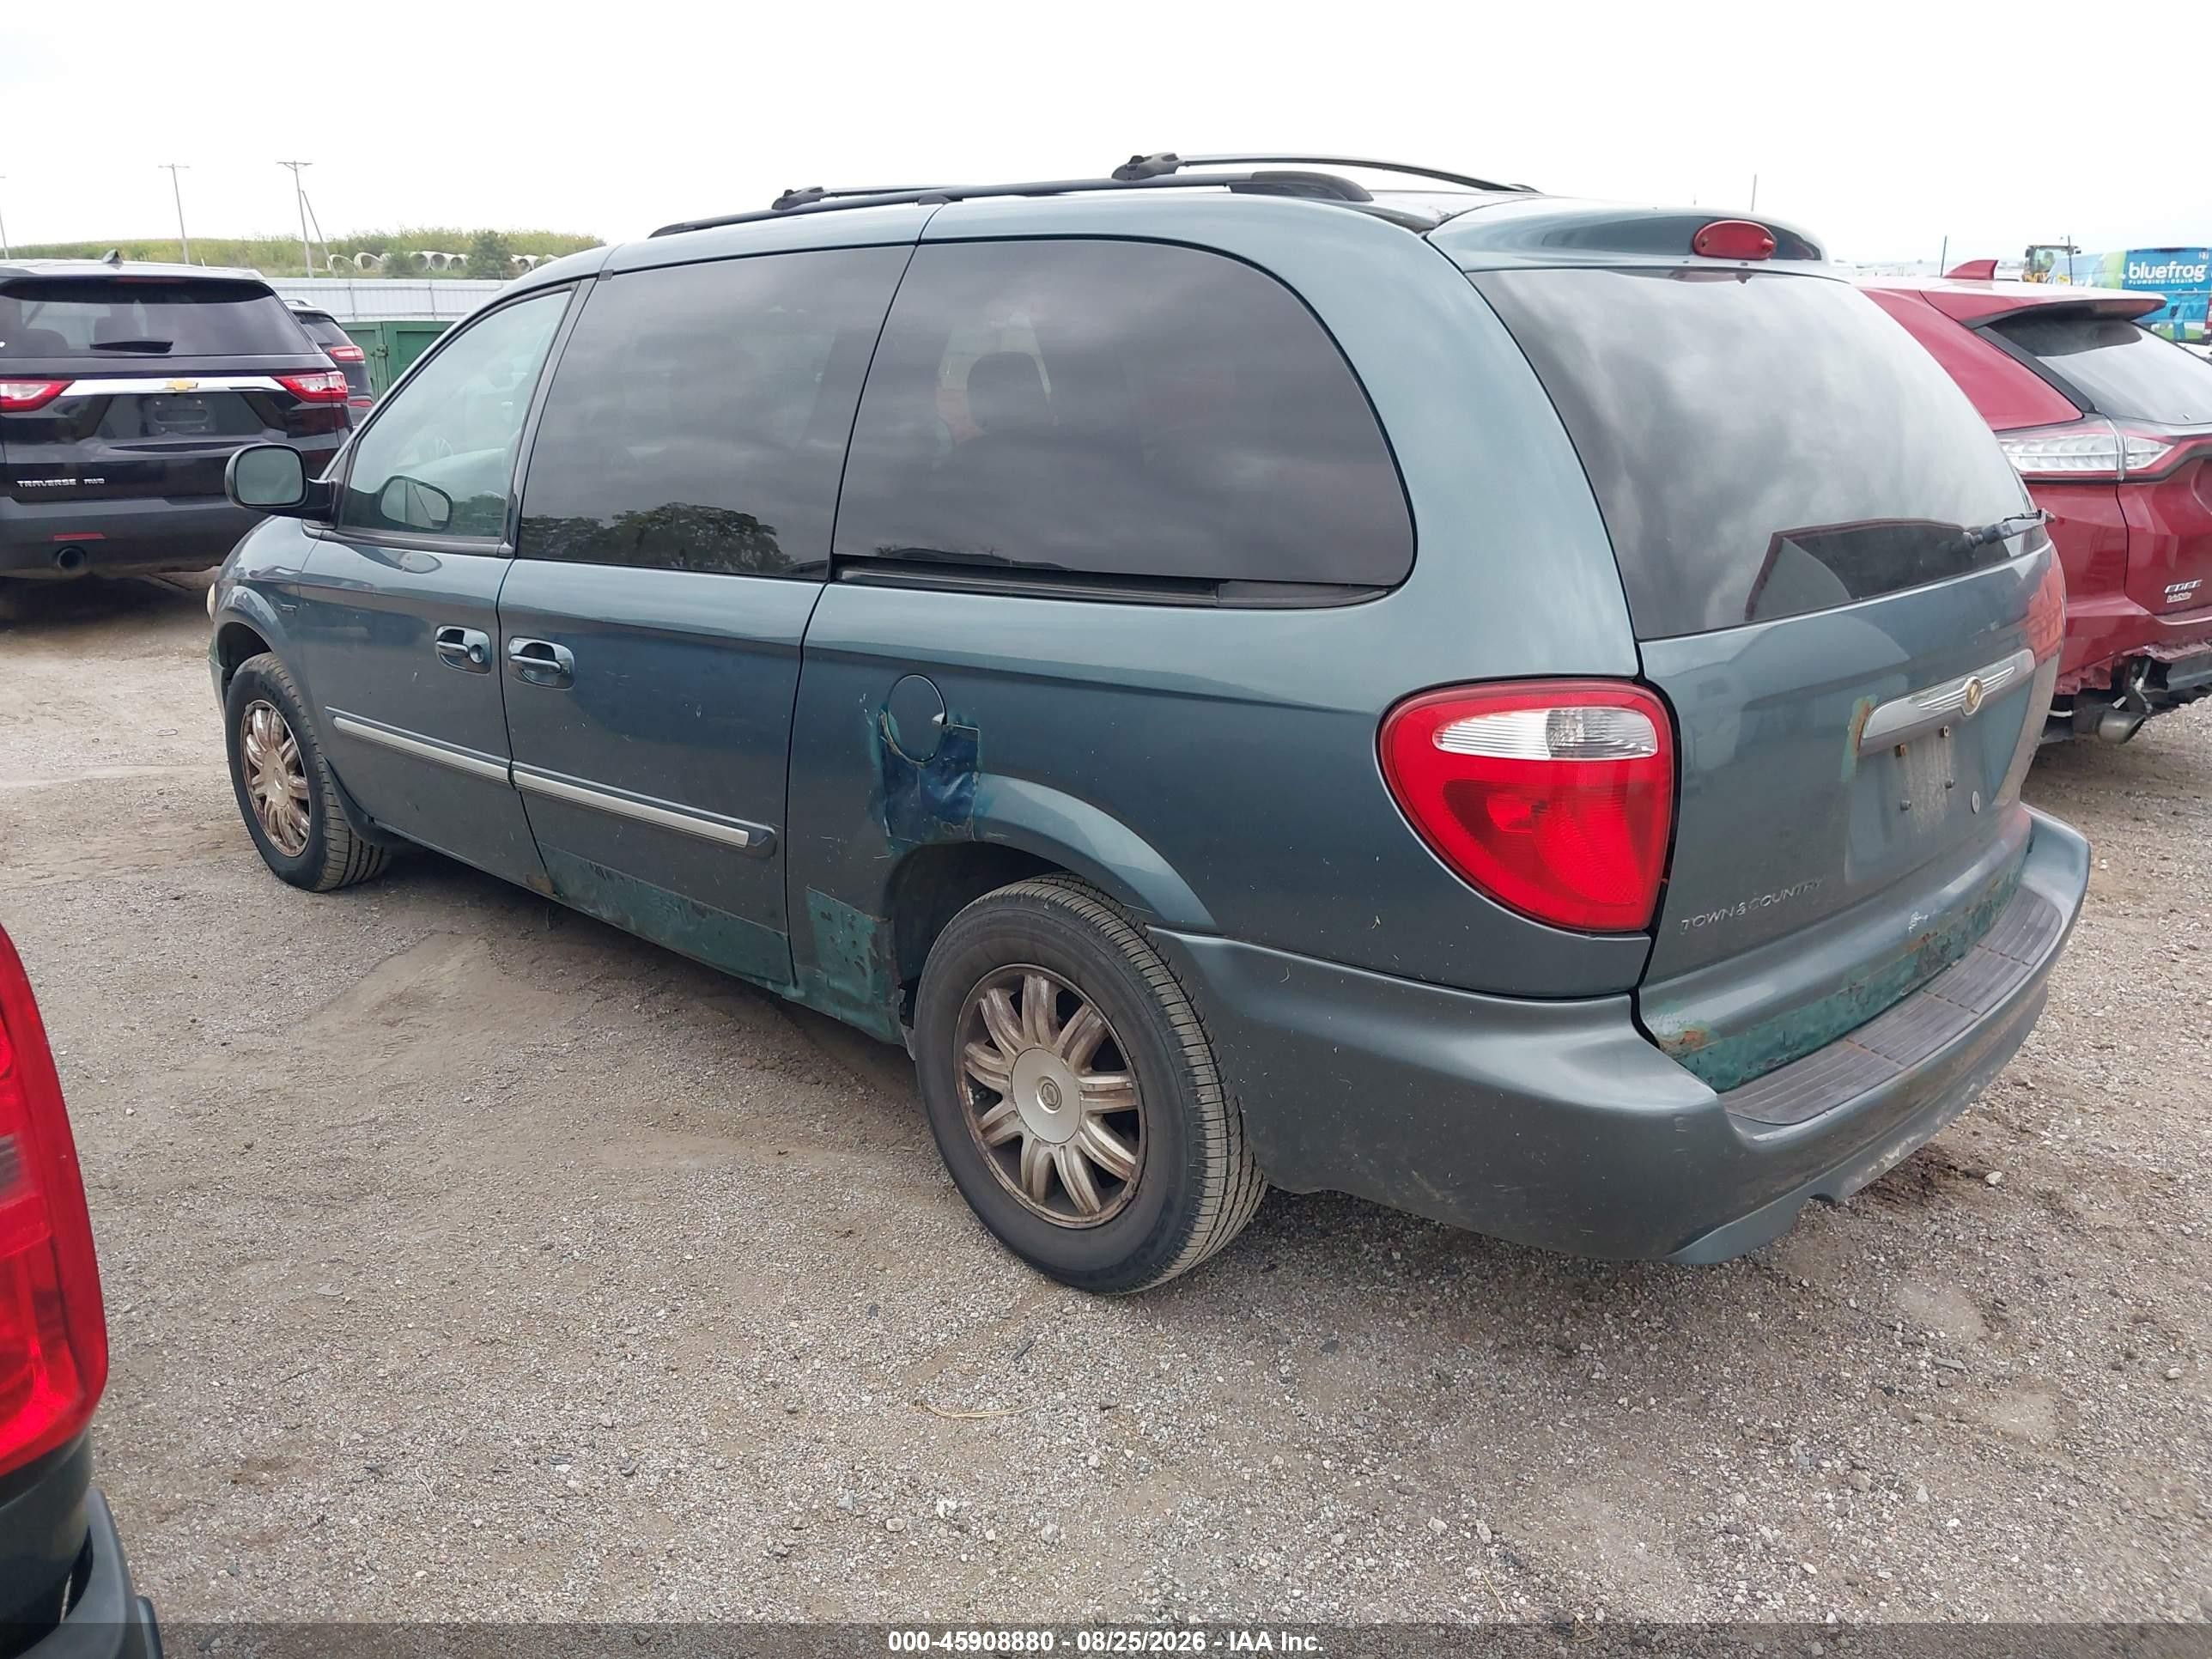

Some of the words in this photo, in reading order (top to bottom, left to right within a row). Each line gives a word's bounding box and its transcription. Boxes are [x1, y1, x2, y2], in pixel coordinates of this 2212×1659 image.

[2129, 260, 2208, 283] bluefrog
[16, 478, 76, 488] TRAVERSE
[2164, 579, 2203, 594] EDGE
